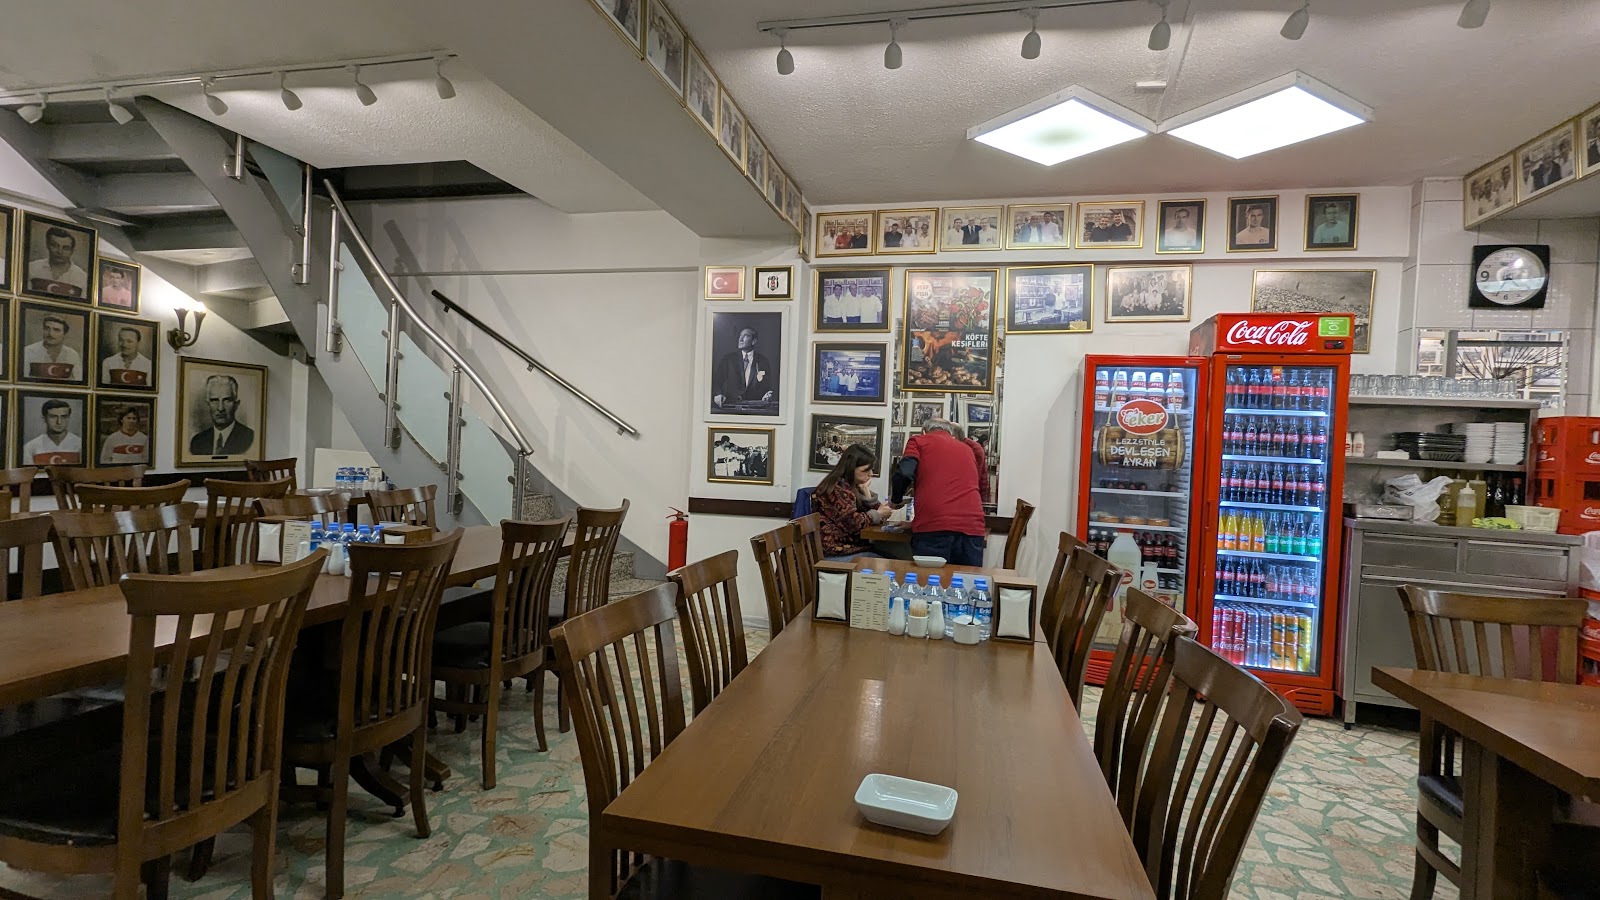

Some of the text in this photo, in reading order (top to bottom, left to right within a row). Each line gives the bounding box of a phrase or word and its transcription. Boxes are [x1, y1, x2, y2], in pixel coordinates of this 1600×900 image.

[1480, 270, 1489, 282] 9
[965, 333, 988, 341] KÖFTE
[1226, 320, 1314, 345] Coca-Cola
[1110, 446, 1170, 458] DEVLEŞEN
[1122, 457, 1157, 467] AYRAN
